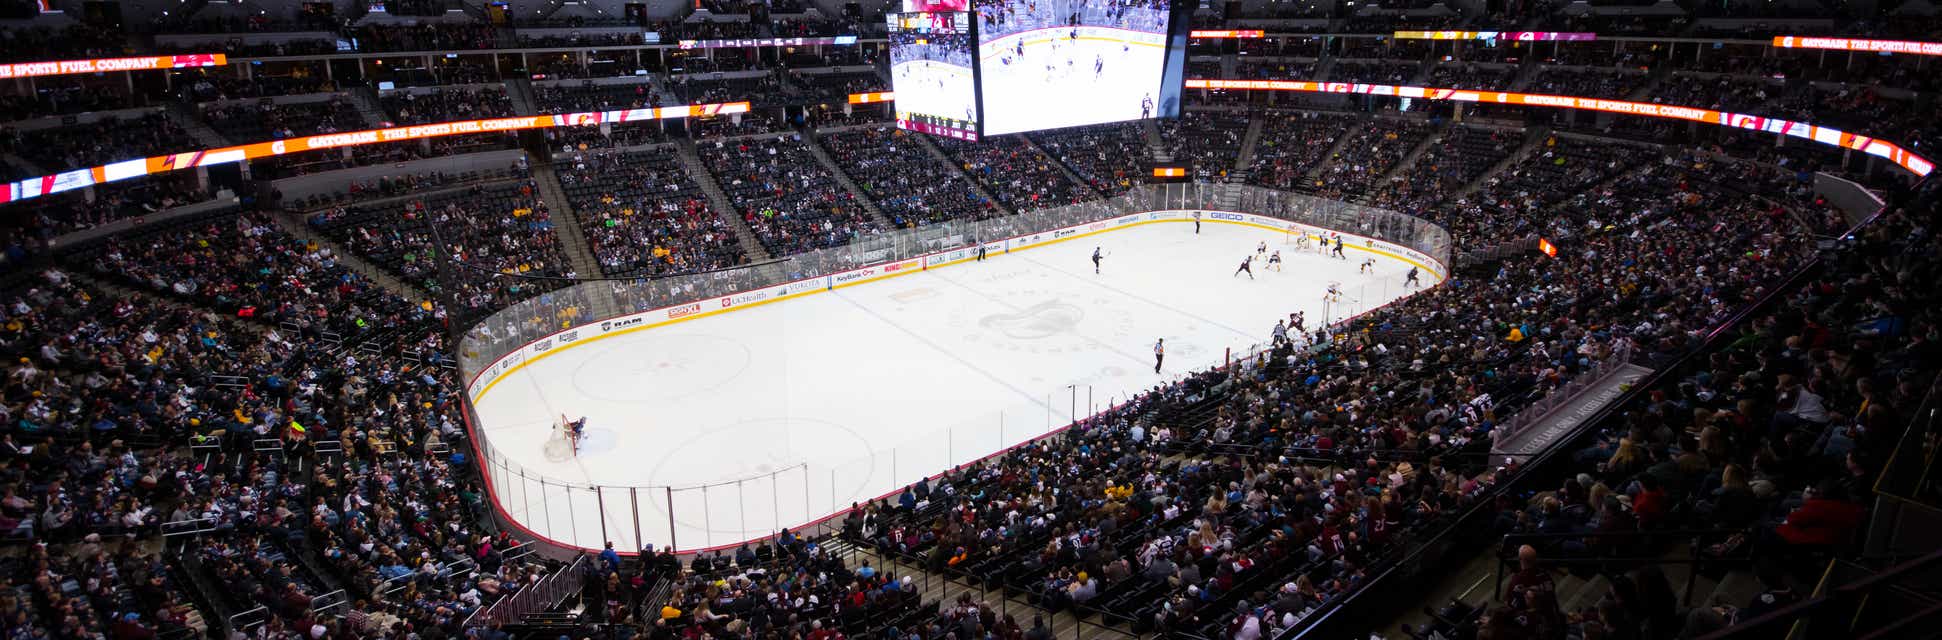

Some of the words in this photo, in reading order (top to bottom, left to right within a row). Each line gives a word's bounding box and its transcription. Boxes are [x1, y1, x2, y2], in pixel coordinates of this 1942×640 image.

[1783, 36, 1793, 48] G
[1801, 37, 1849, 49] GATORADE
[1850, 40, 1870, 50] THE
[1870, 40, 1904, 52] SPORTS
[1904, 41, 1922, 53] FUEL
[14, 62, 58, 77] SPORTS
[61, 59, 95, 75] FUEL
[96, 57, 160, 71] COMPANY
[1524, 95, 1575, 108] GATORADE
[1578, 99, 1597, 109] THE
[1598, 100, 1632, 112] SPORTS
[1633, 103, 1659, 114] FUEL
[1659, 106, 1708, 120] COMPANY
[308, 132, 378, 148] GATORADE
[383, 128, 408, 141] THE
[409, 124, 450, 139] SPORTS
[452, 121, 481, 134] FUEL
[482, 117, 538, 131] COMPANY
[271, 140, 285, 155] G
[1211, 212, 1244, 221] GEICO
[732, 290, 767, 306] UCHealth
[614, 316, 643, 329] RAM
